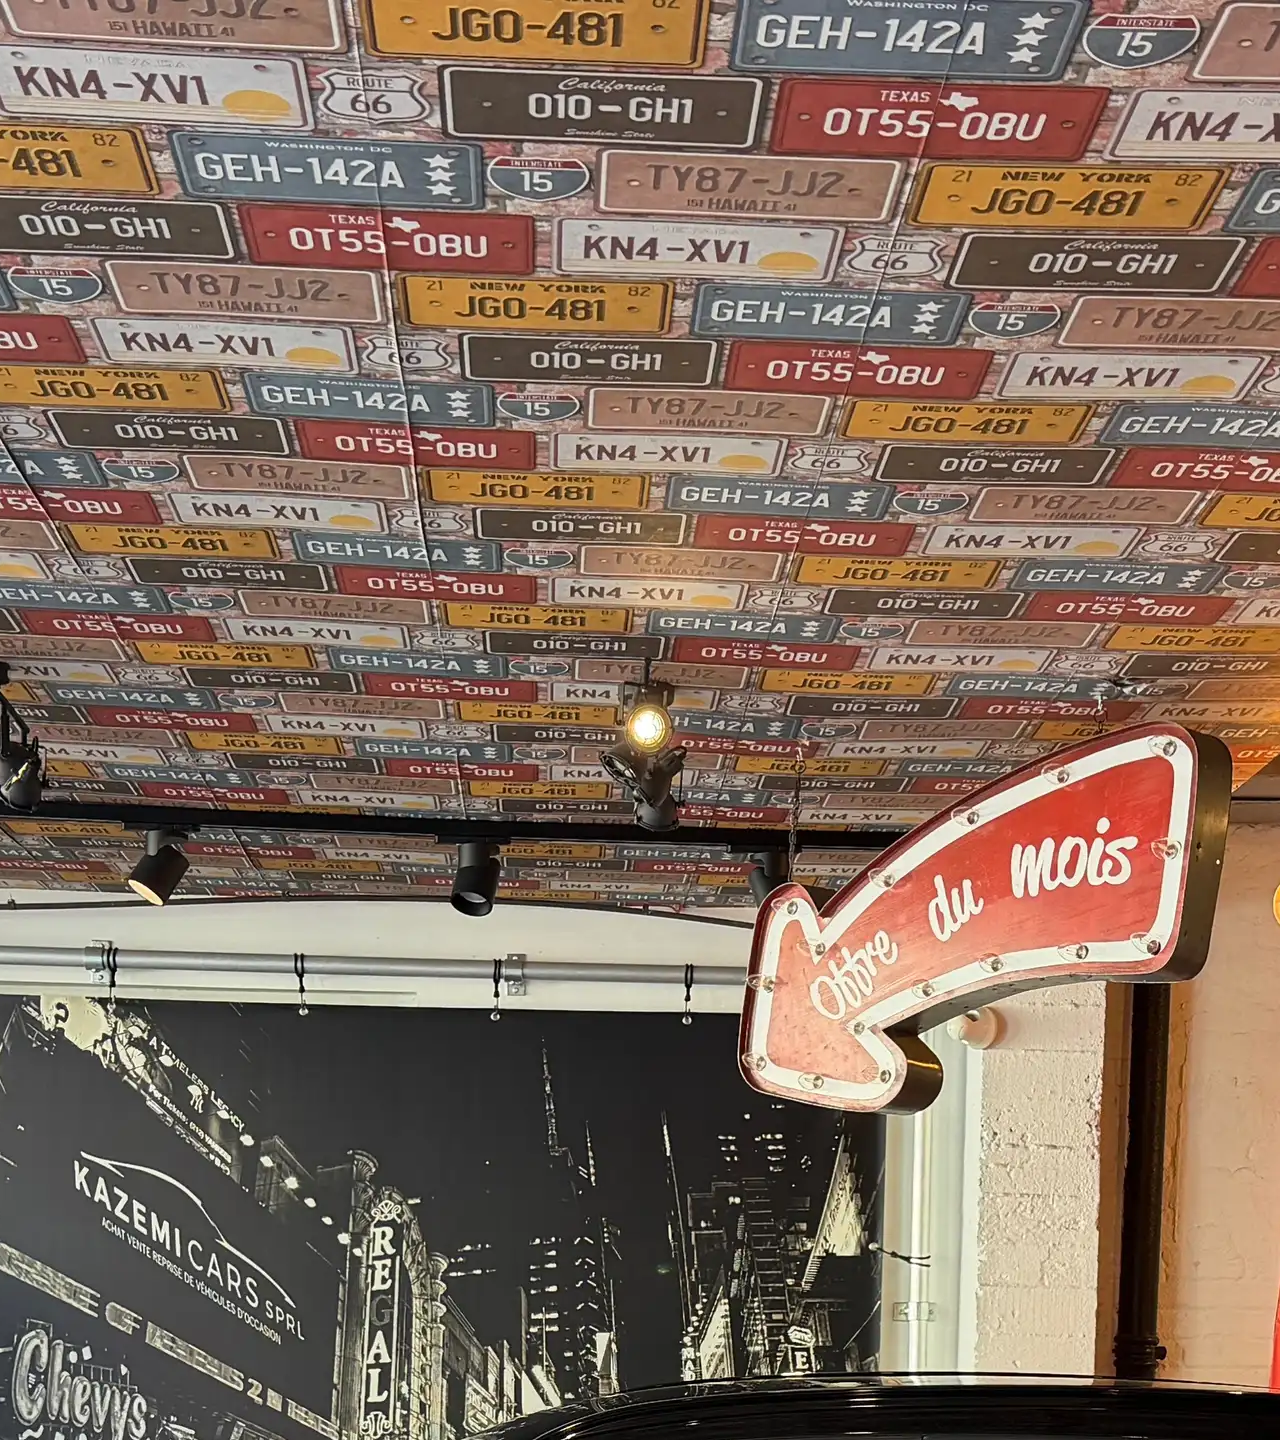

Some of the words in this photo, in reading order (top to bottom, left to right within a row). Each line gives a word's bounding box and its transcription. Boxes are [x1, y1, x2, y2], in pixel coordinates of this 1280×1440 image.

[846, 0, 957, 11] WASHINGTON
[961, 2, 988, 11] DC
[757, 11, 993, 59] GEH-142A
[1112, 31, 1161, 59] 15
[345, 77, 395, 88] ROUTE
[558, 76, 667, 94] California
[347, 92, 392, 114] 66
[877, 89, 932, 104] TEXAS
[197, 152, 405, 190] GEH-142A
[951, 170, 973, 182] 21
[1000, 170, 1068, 183] NEW
[1074, 170, 1155, 185] YORK
[1172, 174, 1203, 187] 82
[521, 171, 554, 193] 15
[38, 200, 139, 215] California
[707, 198, 781, 213] HAWAII
[328, 214, 375, 226] TEXAS
[874, 241, 920, 250] ROUTE
[868, 253, 910, 270] 66
[39, 278, 76, 296] 15
[712, 298, 897, 329] GEH-142A
[993, 314, 1030, 331] 15
[809, 350, 852, 359] TEXAS
[263, 387, 430, 413] GEH-142A
[1025, 567, 1171, 586] GEH-142A
[809, 929, 899, 1021] Offre
[928, 874, 984, 941] du
[1010, 816, 1138, 898] mois
[74, 1160, 181, 1257] KAZEMI
[188, 1239, 259, 1308] CARS
[265, 1301, 305, 1341] SPRL
[102, 1217, 126, 1240] ACHAT
[127, 1232, 151, 1257] VENTE
[152, 1251, 183, 1280] REPRISE
[184, 1272, 195, 1286] DE
[195, 1276, 236, 1314] VÉHICULES
[237, 1307, 281, 1345] D'OCCASION
[366, 1226, 396, 1402] REGAL
